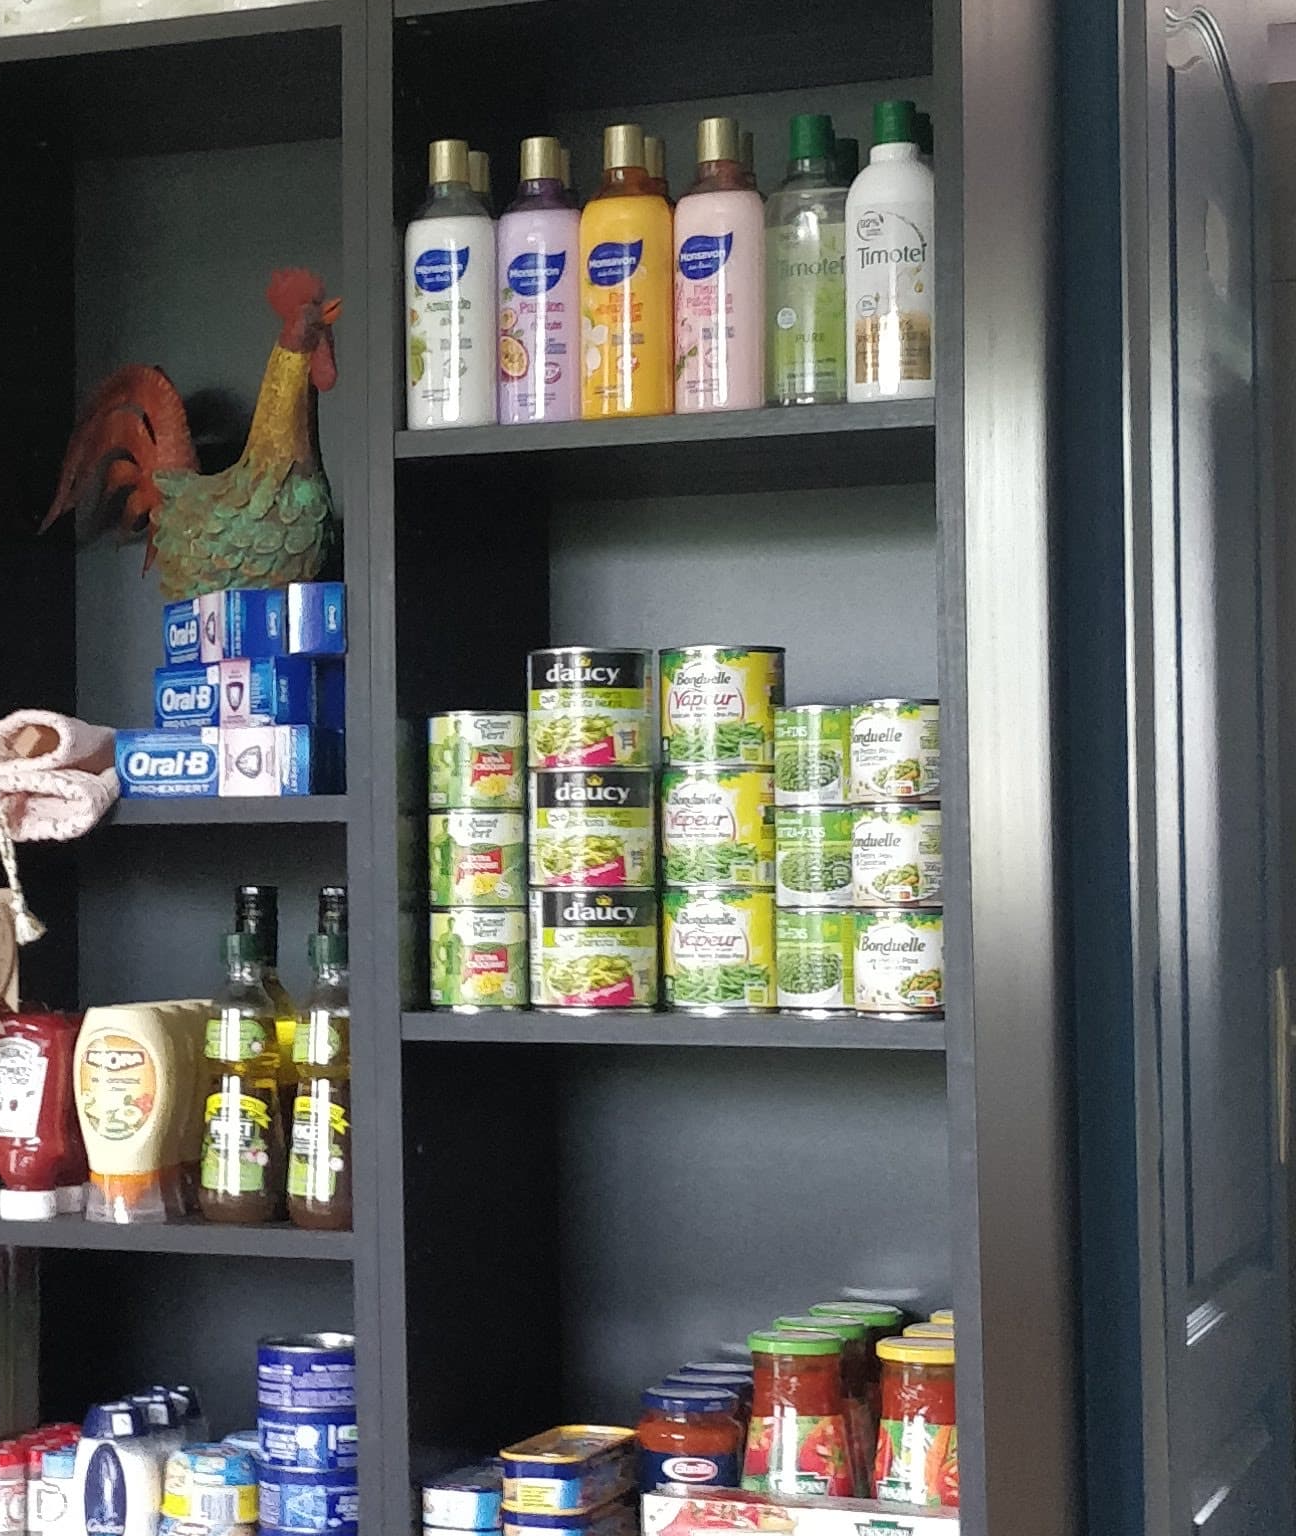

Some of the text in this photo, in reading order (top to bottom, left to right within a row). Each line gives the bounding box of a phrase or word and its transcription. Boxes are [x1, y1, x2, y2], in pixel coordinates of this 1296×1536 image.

[857, 242, 928, 269] Timotei
[169, 620, 198, 648] Oral-B
[161, 684, 212, 712] Oral-B
[673, 690, 738, 711] Vapur
[128, 751, 209, 776] Oral-B
[853, 832, 902, 851] onduelle
[861, 936, 926, 955] Bonduelle
